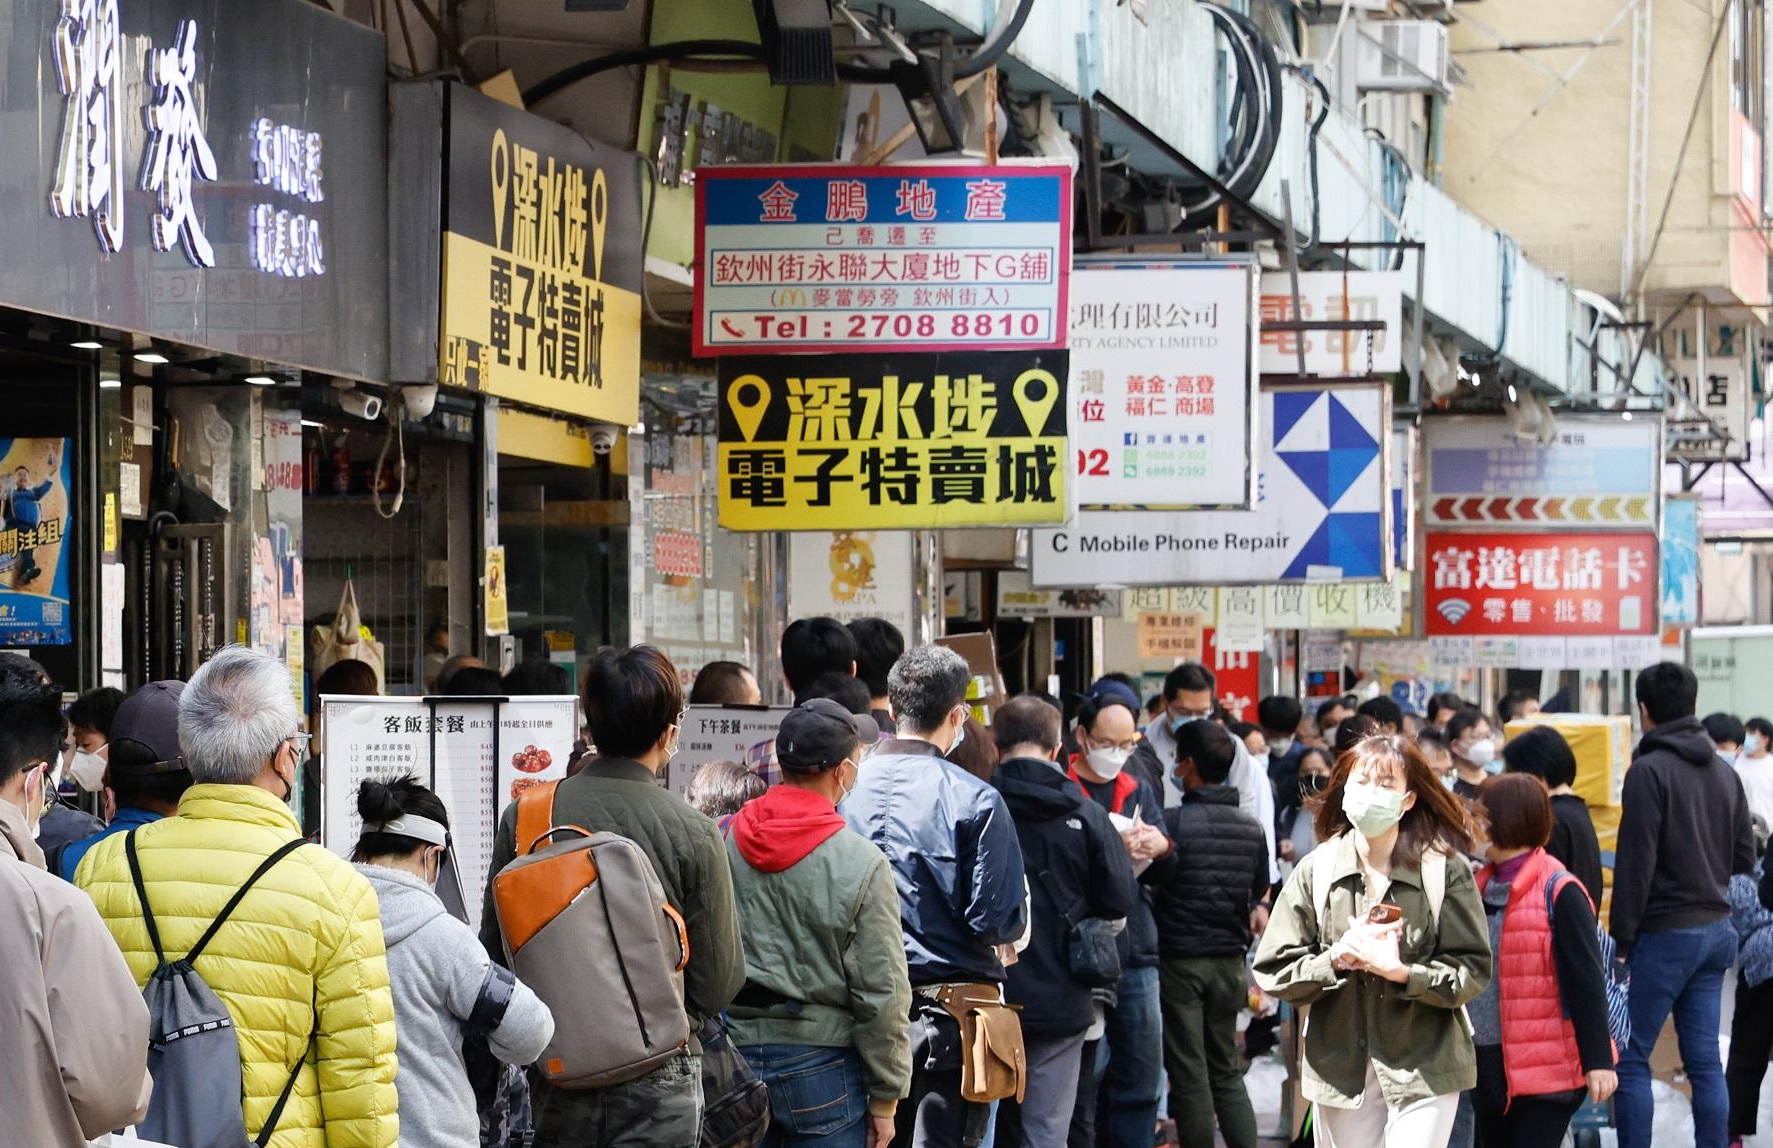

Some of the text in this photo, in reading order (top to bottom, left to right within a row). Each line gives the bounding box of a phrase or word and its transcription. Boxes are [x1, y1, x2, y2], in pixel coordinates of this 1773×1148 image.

[512, 142, 587, 277] 深水埗
[759, 180, 1006, 222] 金鵬地產
[490, 255, 604, 389] 電子特賣城
[847, 315, 936, 338] 2708
[951, 314, 1040, 337] 8810
[1072, 303, 1217, 330] 理有限公司
[1097, 337, 1155, 349] AGENCY
[1160, 336, 1218, 348] LIMITED
[786, 374, 996, 441] 深水埗
[727, 446, 1056, 506] 電子特賣城
[1080, 532, 1149, 554] Mobile
[1156, 531, 1218, 553] Phone
[1225, 531, 1290, 555] Repair
[1433, 546, 1647, 590] 富達電話卡
[383, 715, 553, 734] 客飯套餐 由上午1時起全日供應
[699, 718, 741, 734] 下午茶餐
